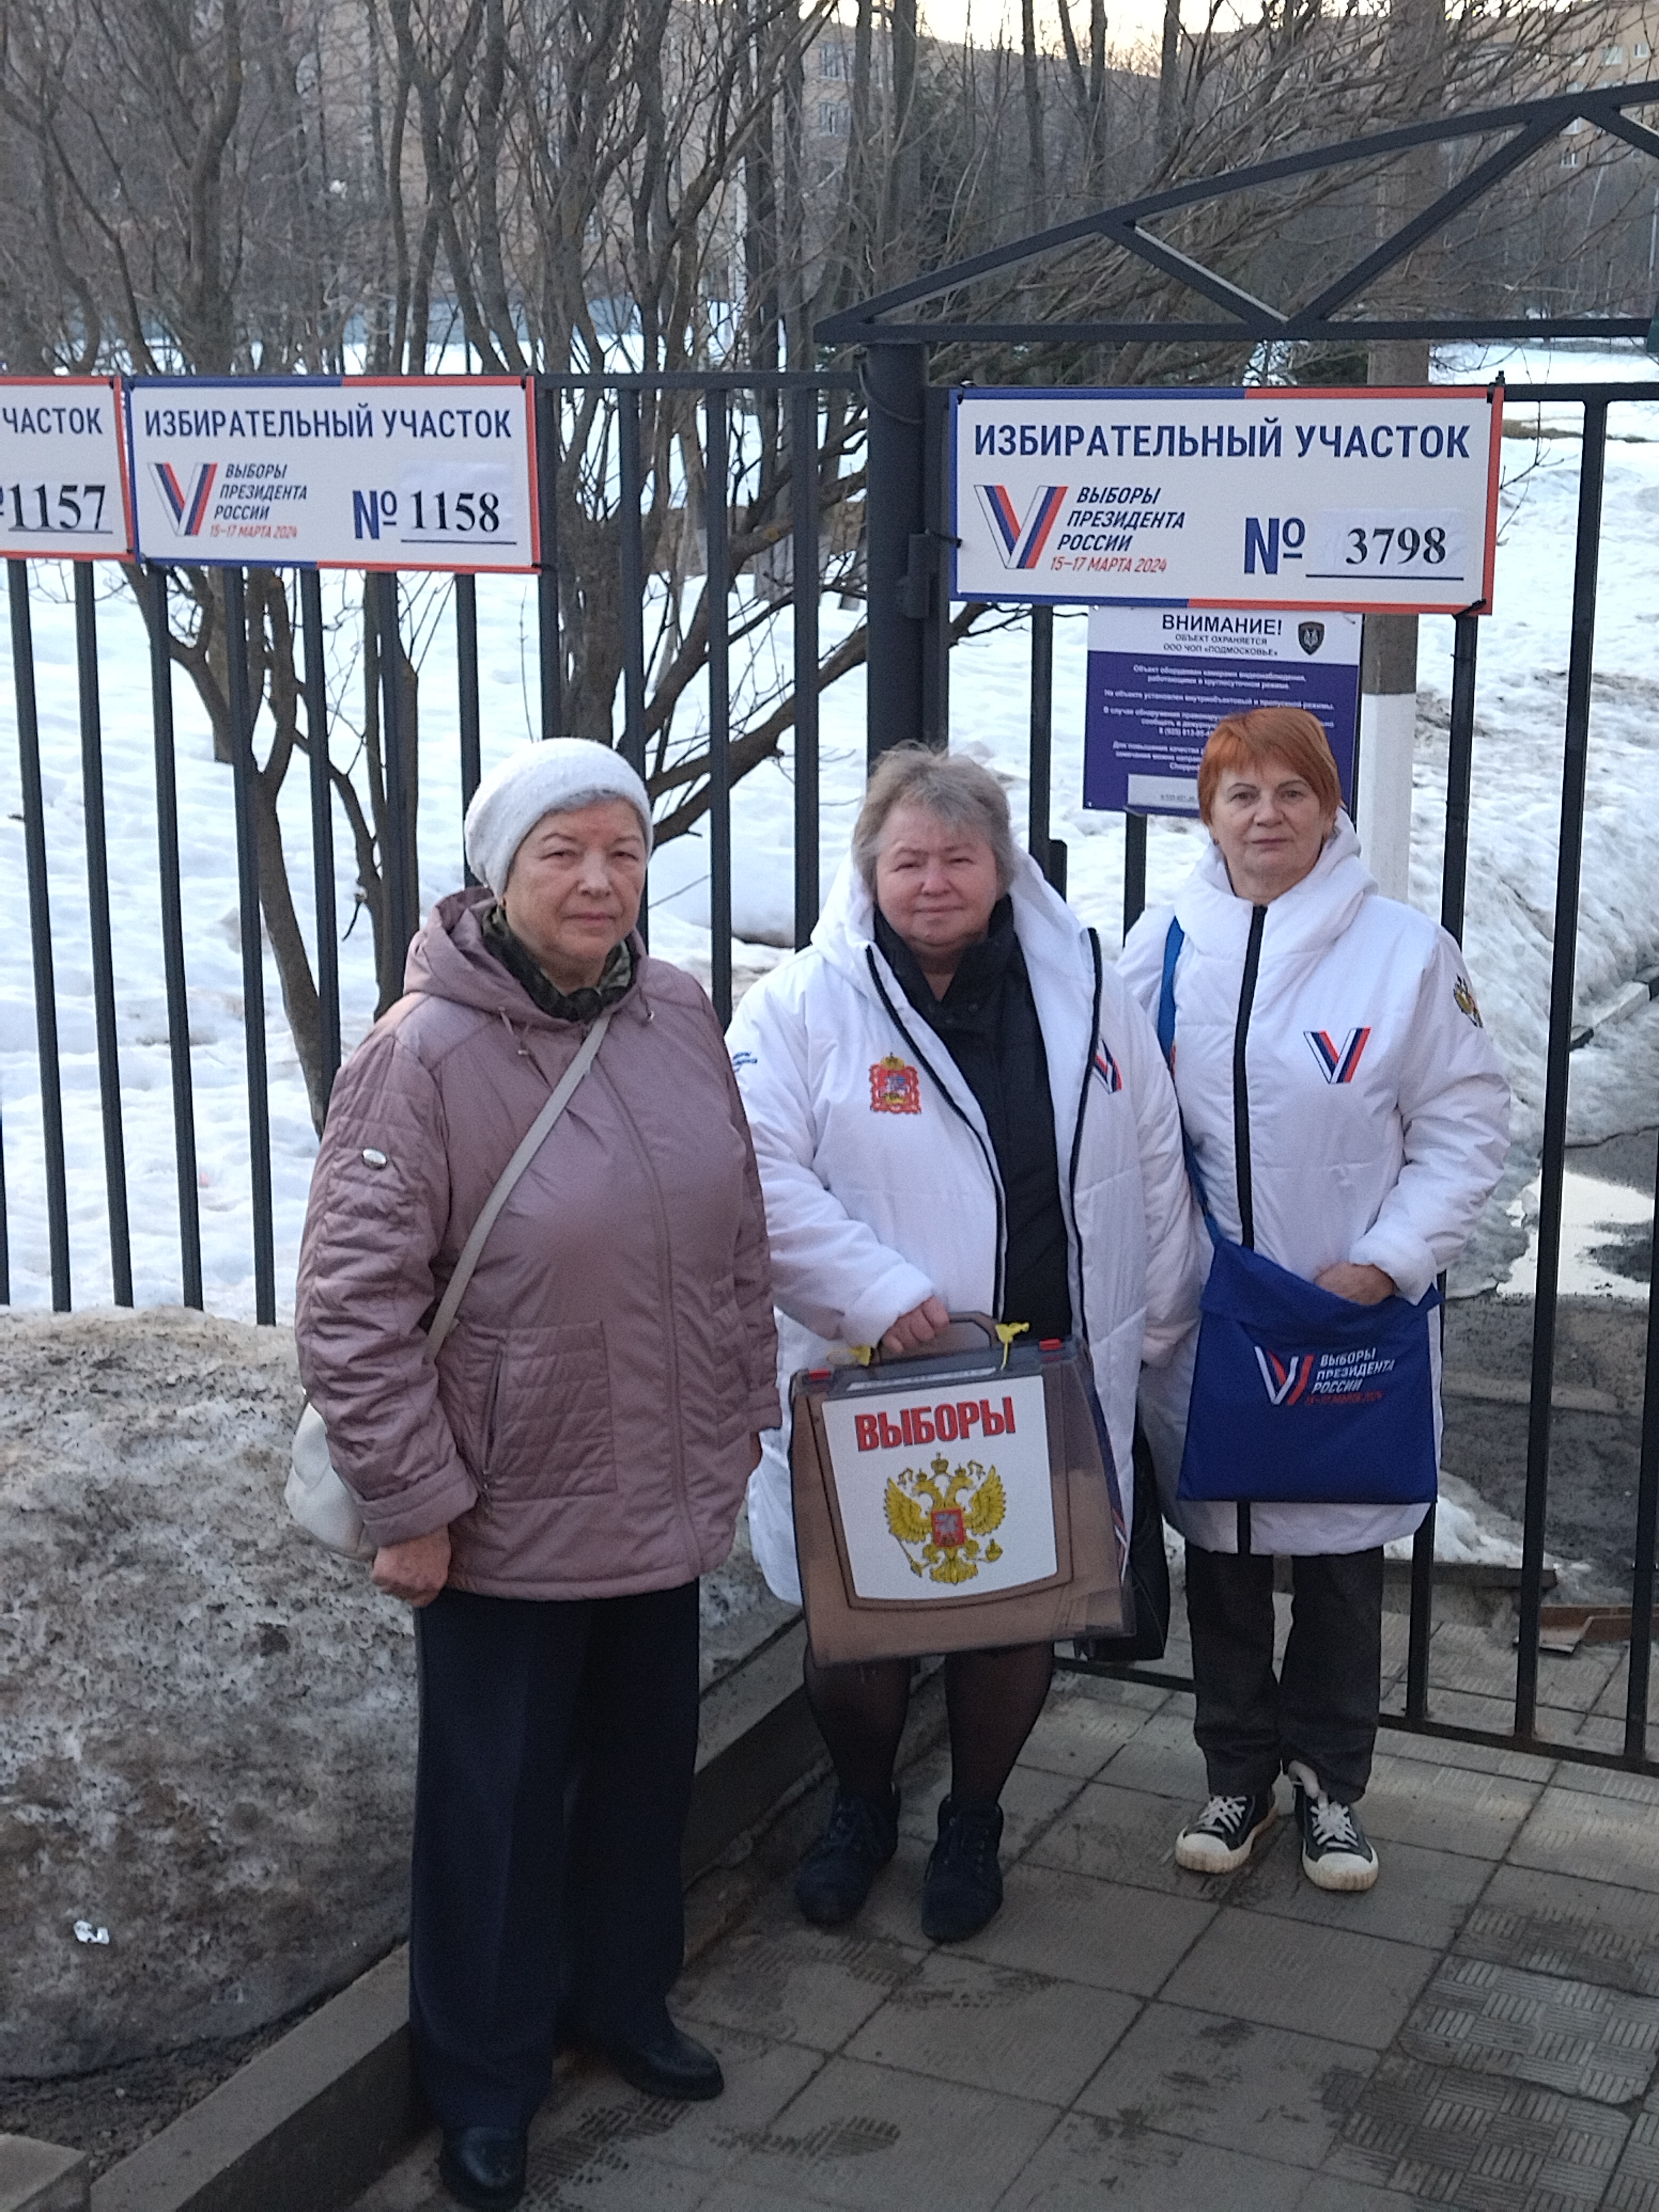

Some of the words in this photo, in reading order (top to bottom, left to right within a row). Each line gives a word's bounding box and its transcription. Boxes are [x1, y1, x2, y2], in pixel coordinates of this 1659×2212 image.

[2, 406, 103, 435] ЧАСТОК
[145, 403, 374, 438] ИЗБИРАТЕЛЬНЫЙ
[384, 409, 512, 439] УЧАСТОК
[974, 418, 1282, 458] ИЗБИРАТЕЛЬНЫЙ
[1296, 425, 1469, 458] УЧАСТОК
[225, 463, 287, 479] ВЫБОРЫ
[220, 484, 307, 502] ПРЕЗИДЕНТА
[1076, 487, 1161, 504] ВЫБОРЫ
[7, 482, 106, 531] 1157
[214, 505, 270, 520] РОССИИ
[352, 490, 398, 540] №
[410, 489, 500, 532] 1158
[1067, 510, 1185, 531] ПРЕЗИДЕНТА
[238, 525, 271, 539] МАРТА
[273, 526, 298, 539] 2024
[1057, 534, 1134, 552] РОССИИ
[1244, 517, 1306, 575] №
[1345, 526, 1448, 565] 3798
[1087, 557, 1132, 573] МАРТА
[1134, 557, 1168, 573] 2024
[1162, 614, 1283, 636] ВНИМАНИЕ!
[1163, 643, 1182, 652] ООО
[1175, 633, 1209, 643] ОБЪЕКТ
[1320, 1347, 1376, 1368] ВЫБОРЫ
[1316, 1359, 1395, 1381] ПРЕЗИДЕНТА
[1311, 1379, 1364, 1394] РОССИИ
[855, 1396, 1016, 1452] ВЫБОРЫ
